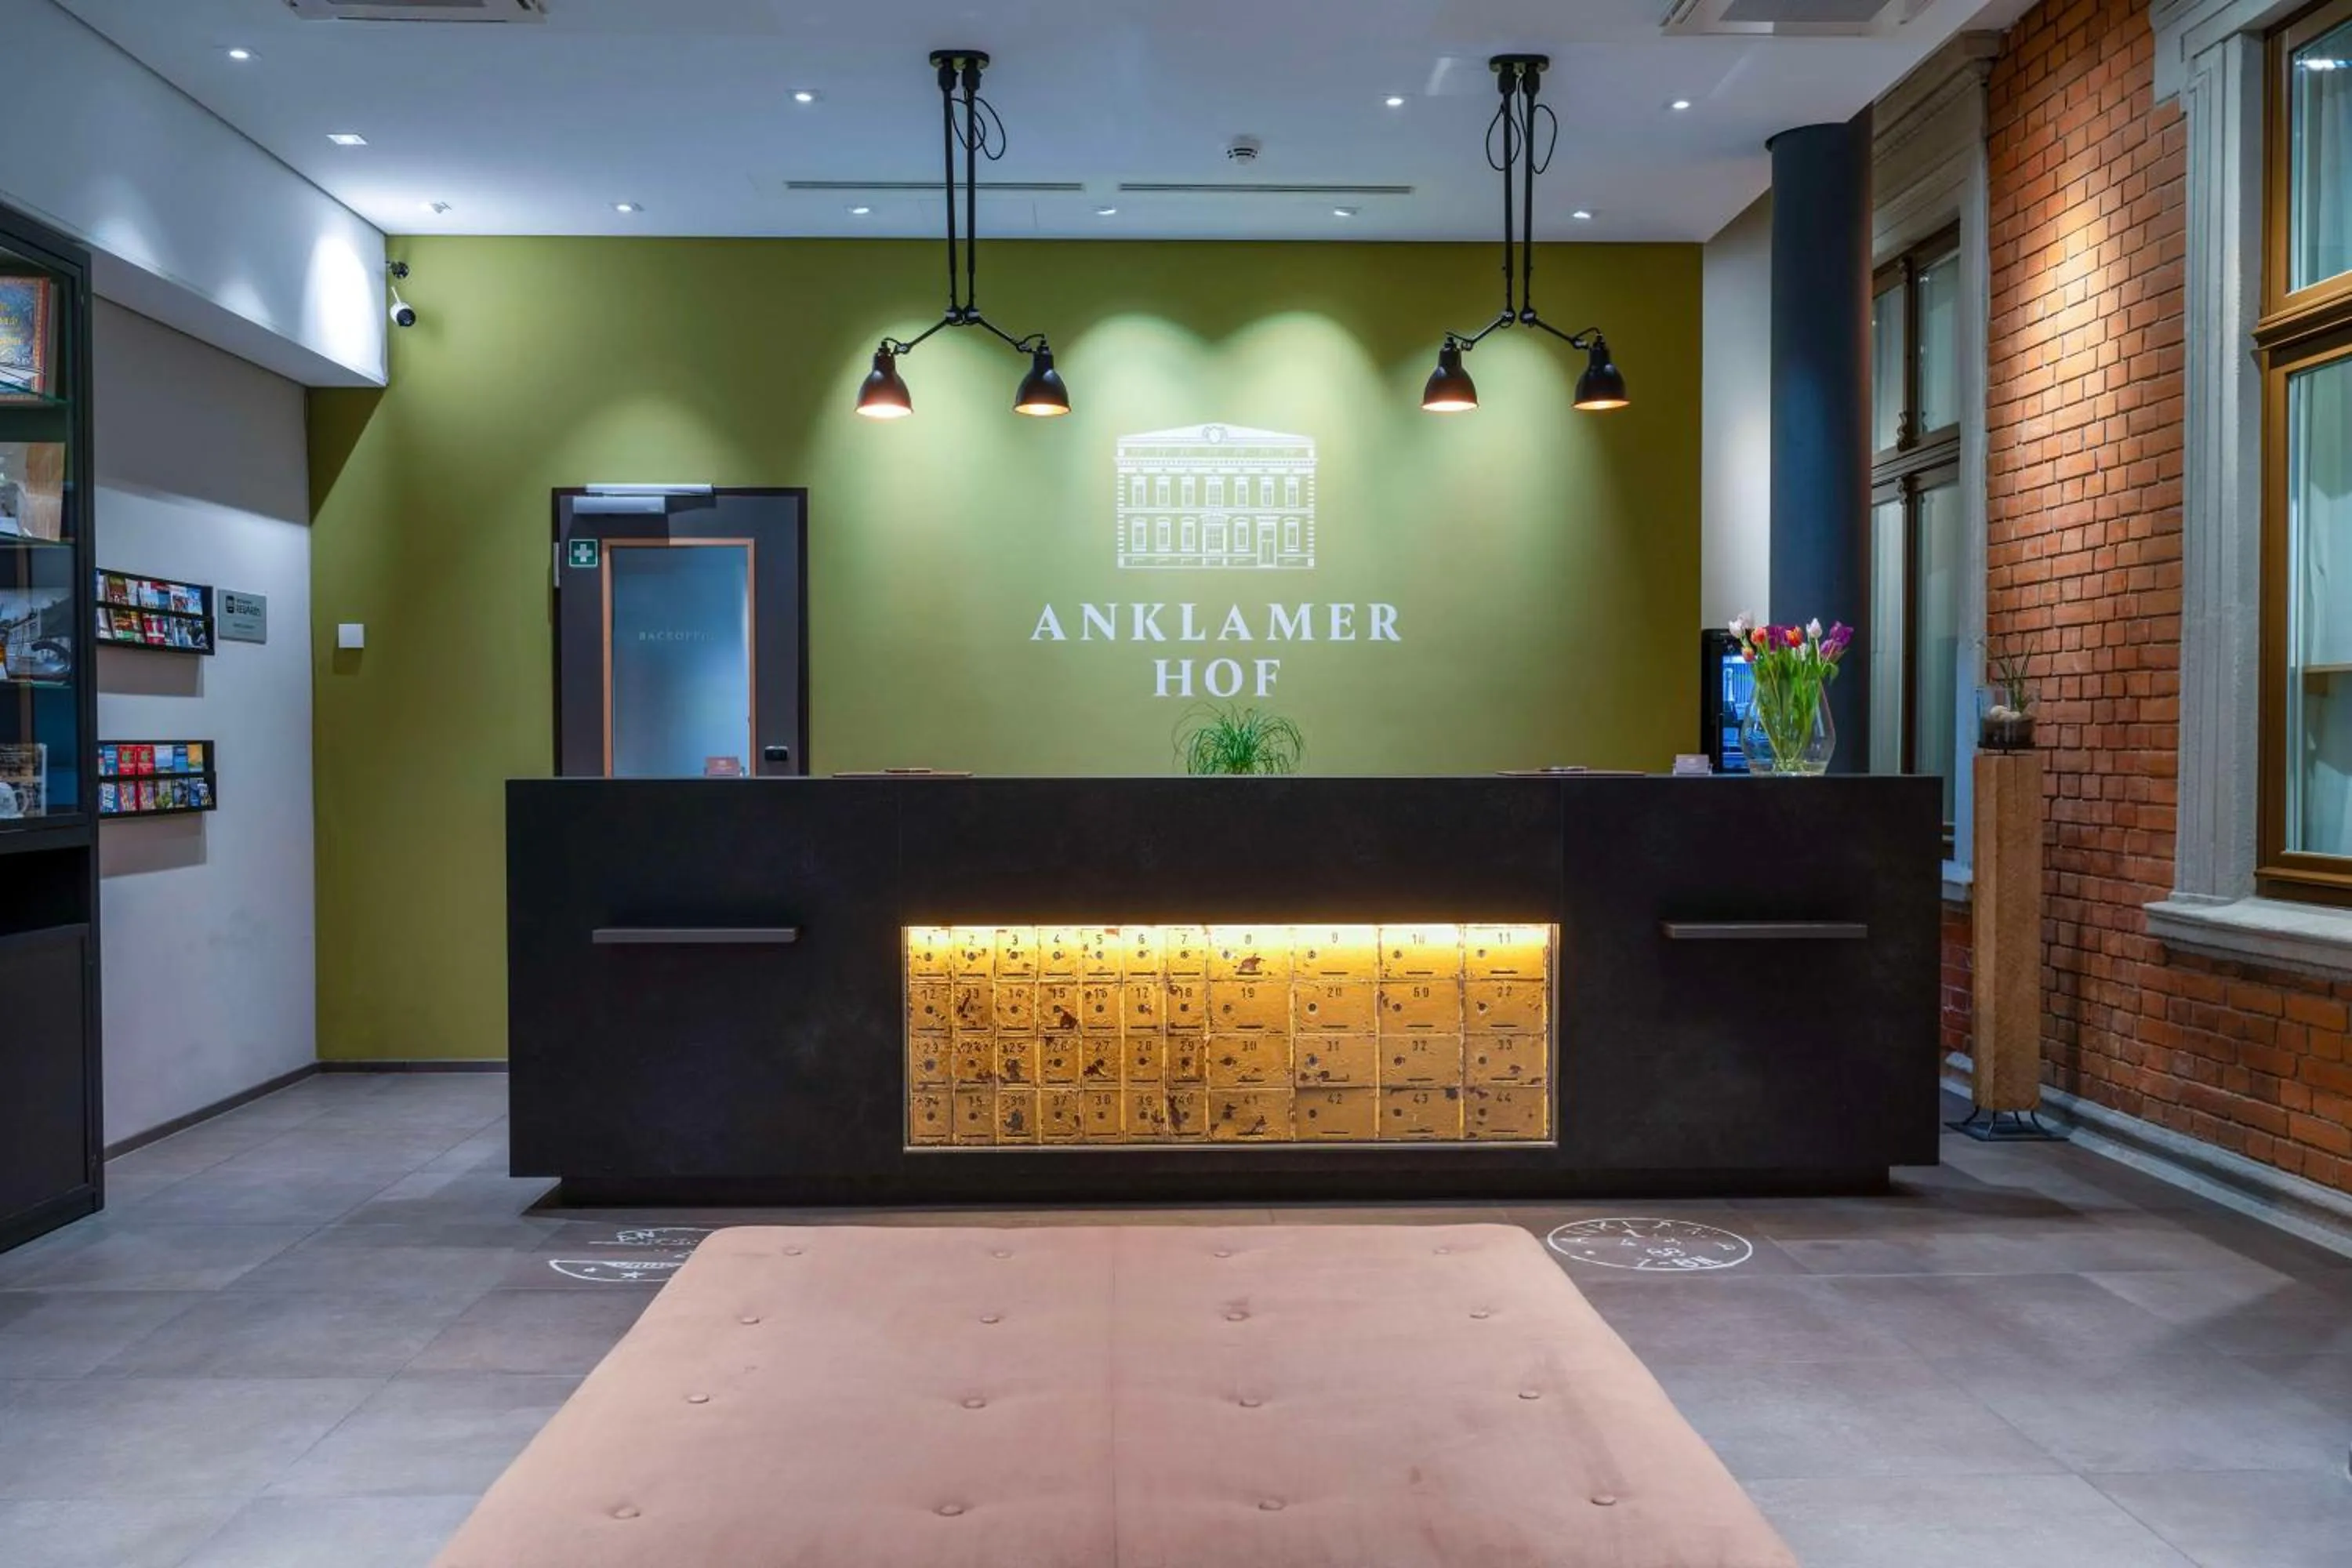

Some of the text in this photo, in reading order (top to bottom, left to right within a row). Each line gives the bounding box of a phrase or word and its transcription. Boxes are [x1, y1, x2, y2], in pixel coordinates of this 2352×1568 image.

[1030, 603, 1402, 641] ANKLAMER
[1152, 658, 1280, 697] HOF
[927, 935, 933, 946] 1
[968, 935, 976, 946] 2
[1011, 934, 1019, 946] 3
[1053, 934, 1060, 946] 4
[1096, 934, 1104, 945] 5
[1138, 934, 1145, 945] 6
[1181, 934, 1189, 945] 7
[1497, 932, 1512, 944] 11
[921, 989, 936, 1001] 12
[1008, 989, 1022, 1000] 14
[1054, 989, 1066, 999] 15
[1094, 989, 1108, 1000] 16
[1135, 987, 1149, 999] 17
[1180, 987, 1192, 999] 18
[1241, 987, 1255, 999] 19
[1327, 986, 1342, 998] 20
[1497, 985, 1513, 998] 22
[923, 1043, 938, 1054] 23
[1007, 1042, 1025, 1053] 25
[1053, 1042, 1068, 1053] 26
[1096, 1040, 1111, 1053] 27
[1137, 1040, 1152, 1052] 28
[1179, 1040, 1195, 1052] 29
[1242, 1040, 1258, 1051] 30
[1327, 1040, 1340, 1051] 31
[1413, 1039, 1428, 1051] 32
[1497, 1039, 1513, 1051] 33
[1053, 1095, 1068, 1106] 37
[1327, 1092, 1342, 1105] 42
[1413, 1092, 1428, 1104] 43
[1497, 1092, 1512, 1103] 44
